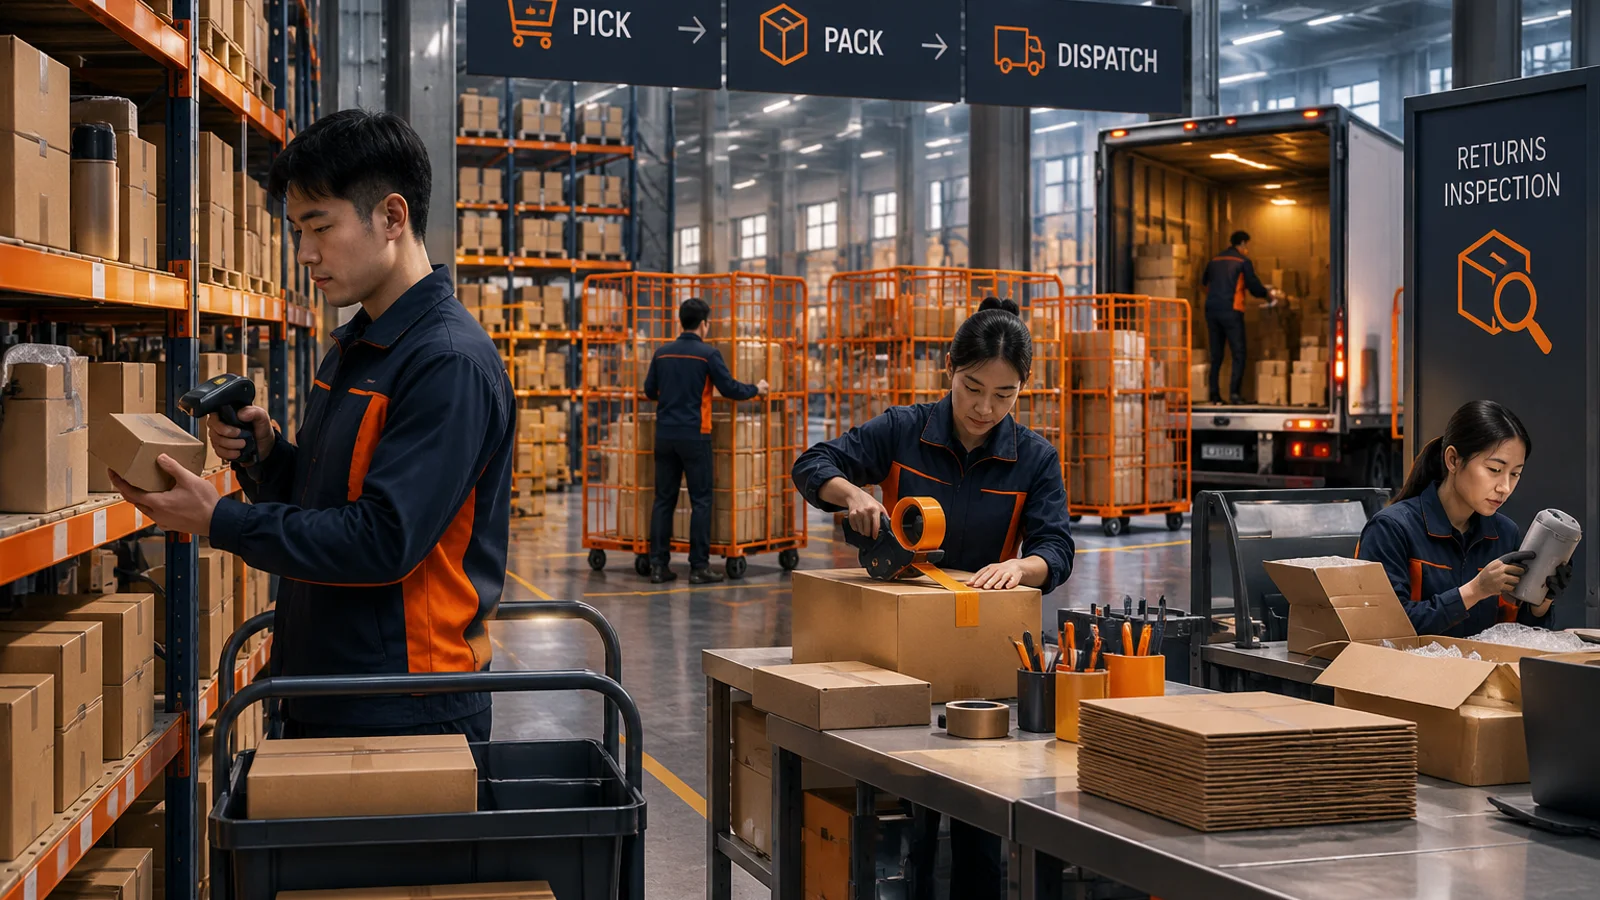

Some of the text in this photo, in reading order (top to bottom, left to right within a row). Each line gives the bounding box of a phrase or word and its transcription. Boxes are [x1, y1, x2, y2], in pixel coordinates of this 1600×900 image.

[573, 7, 632, 39] PICK
[824, 26, 884, 56] PACK
[1058, 42, 1158, 74] DISPATCH
[1457, 136, 1547, 170] RETURNS
[1444, 171, 1560, 207] INSPECTION
